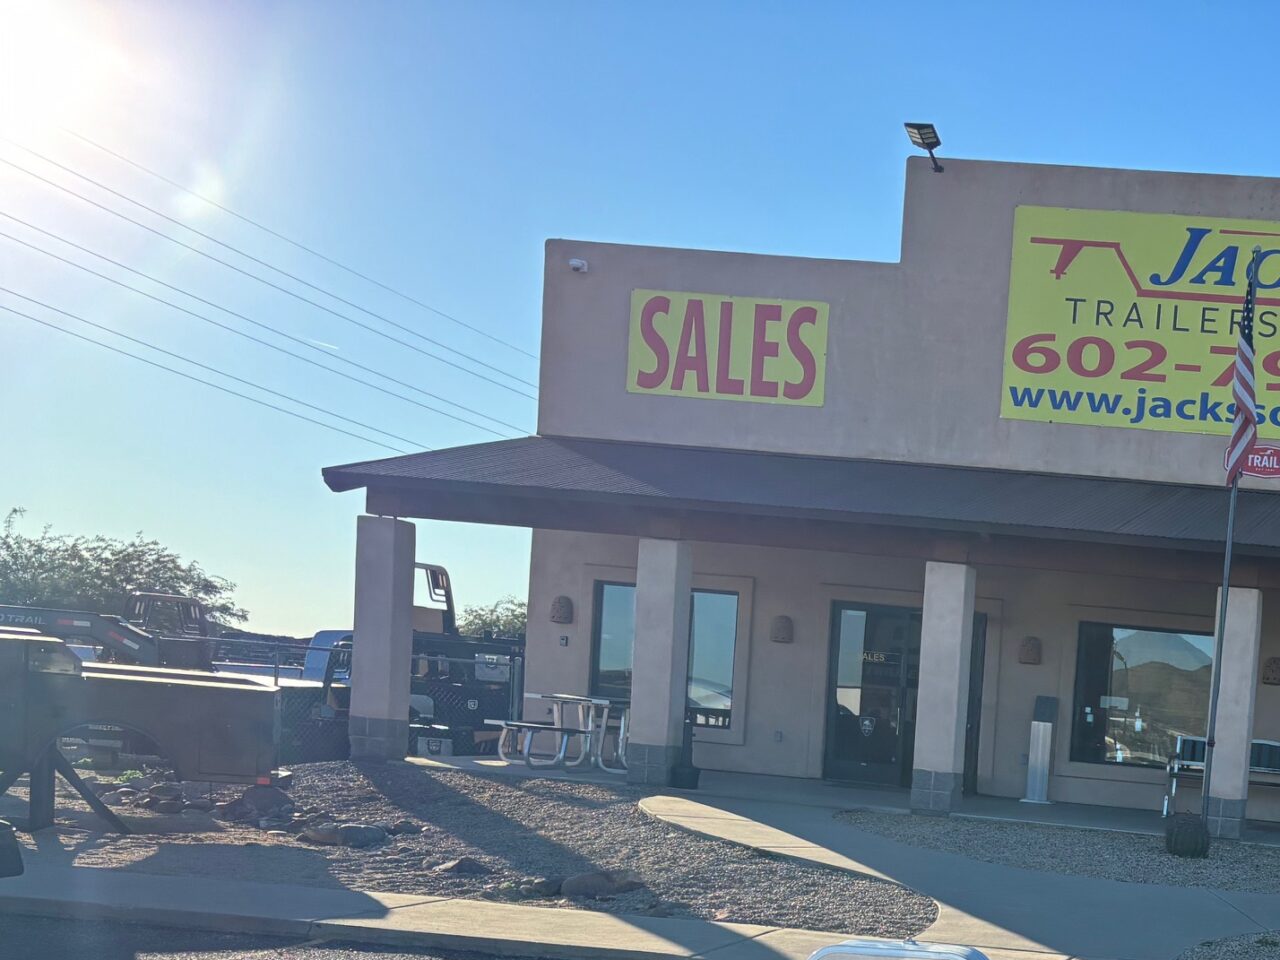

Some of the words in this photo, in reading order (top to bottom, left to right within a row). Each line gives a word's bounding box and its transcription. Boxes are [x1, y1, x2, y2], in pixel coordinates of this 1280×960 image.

[1065, 297, 1279, 338] TRAILERS
[636, 296, 819, 400] SALES
[7, 614, 46, 625] TRAIL
[858, 651, 885, 662] ALES
